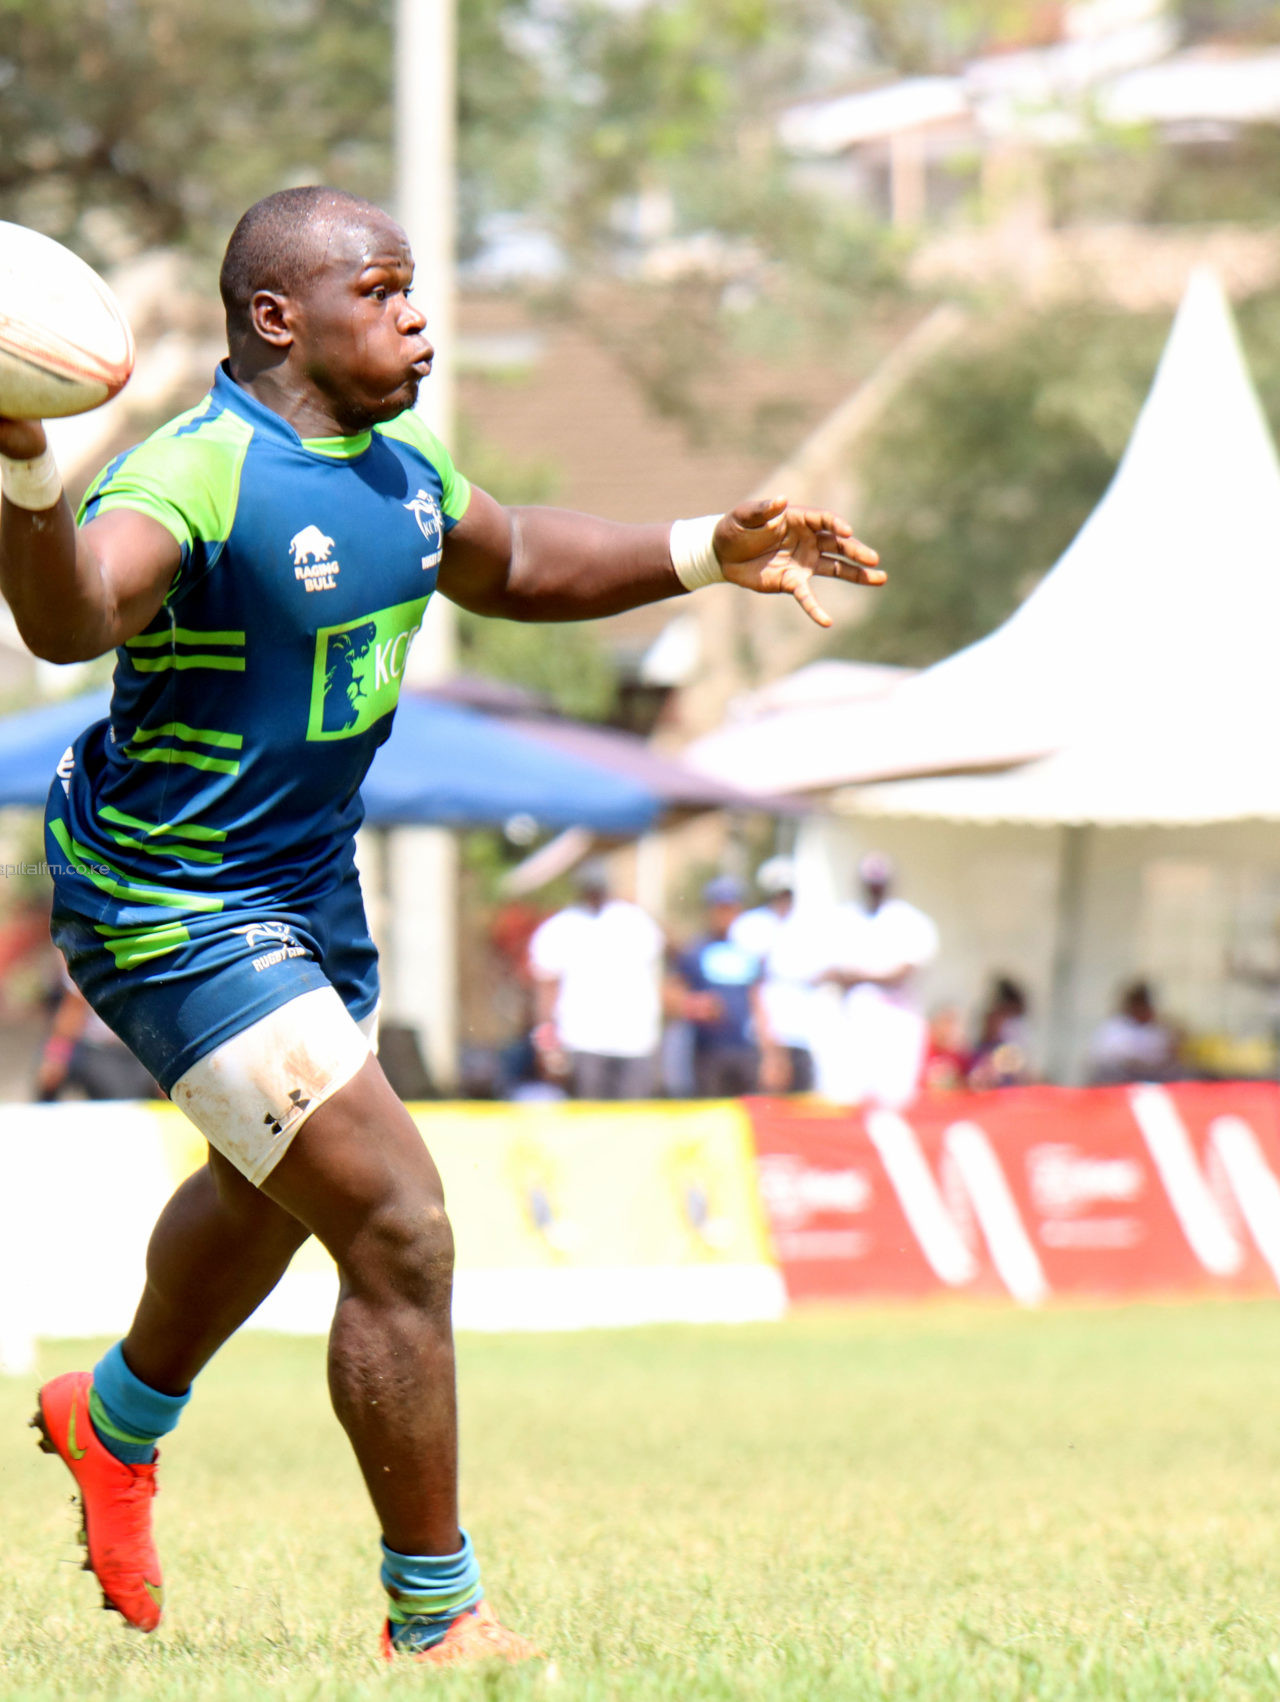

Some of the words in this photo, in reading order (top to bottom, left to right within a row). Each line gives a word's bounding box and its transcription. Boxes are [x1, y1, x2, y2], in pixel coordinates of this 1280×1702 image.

[294, 560, 340, 580] RAGING
[305, 575, 336, 593] BULL
[252, 945, 287, 972] RUGBY
